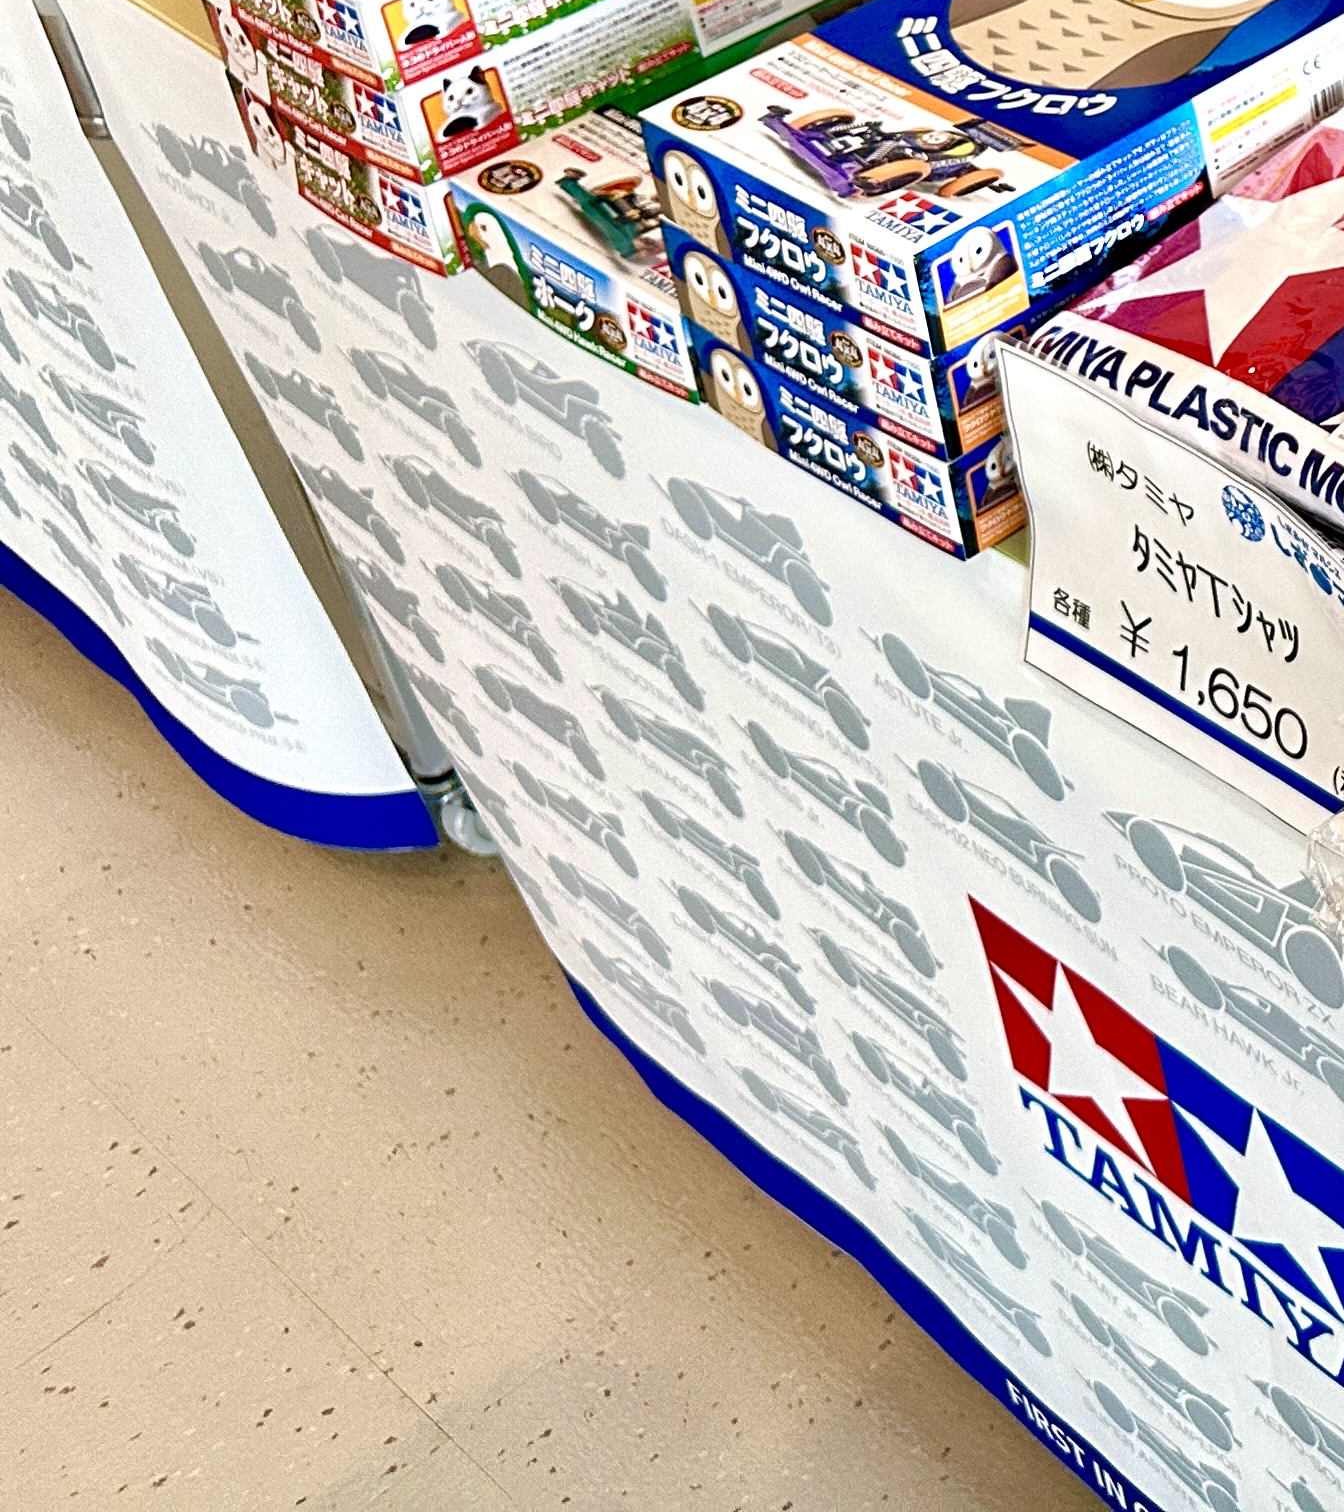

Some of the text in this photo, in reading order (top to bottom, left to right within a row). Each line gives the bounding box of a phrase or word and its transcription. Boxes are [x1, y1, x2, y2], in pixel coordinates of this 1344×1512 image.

[321, 24, 368, 52] TAMIYA
[896, 15, 1118, 117] ミニ四駆フクロウ
[358, 115, 403, 140] TAMIYA
[383, 208, 428, 237] TAMIYA
[734, 185, 808, 240] ミニ四駆
[865, 209, 923, 244] TAMIYA
[529, 243, 597, 304] ミニ四駆
[735, 216, 827, 285] フクロウ
[533, 276, 596, 332] ホーク
[754, 287, 826, 345] ミニ四駆
[810, 287, 844, 313] Racer
[856, 278, 914, 316] TAMIYA
[632, 333, 682, 367] TAMIYA
[756, 317, 844, 385] フクロウ
[779, 386, 849, 447] ミニ四駆
[871, 380, 930, 419] TAMIYA
[1128, 358, 1299, 477] PLASTIC
[779, 415, 868, 484] フクロウ
[893, 481, 948, 521] TAMIYA
[1132, 525, 1301, 663] タミヤTシャツ
[1052, 587, 1309, 761] 各種 ¥ 1,650
[1116, 852, 1182, 917] PROTO
[1184, 899, 1301, 1005] EMPEROR
[1150, 973, 1276, 1079] BEAR HAWK
[1006, 1378, 1127, 1507] FIRST IN
